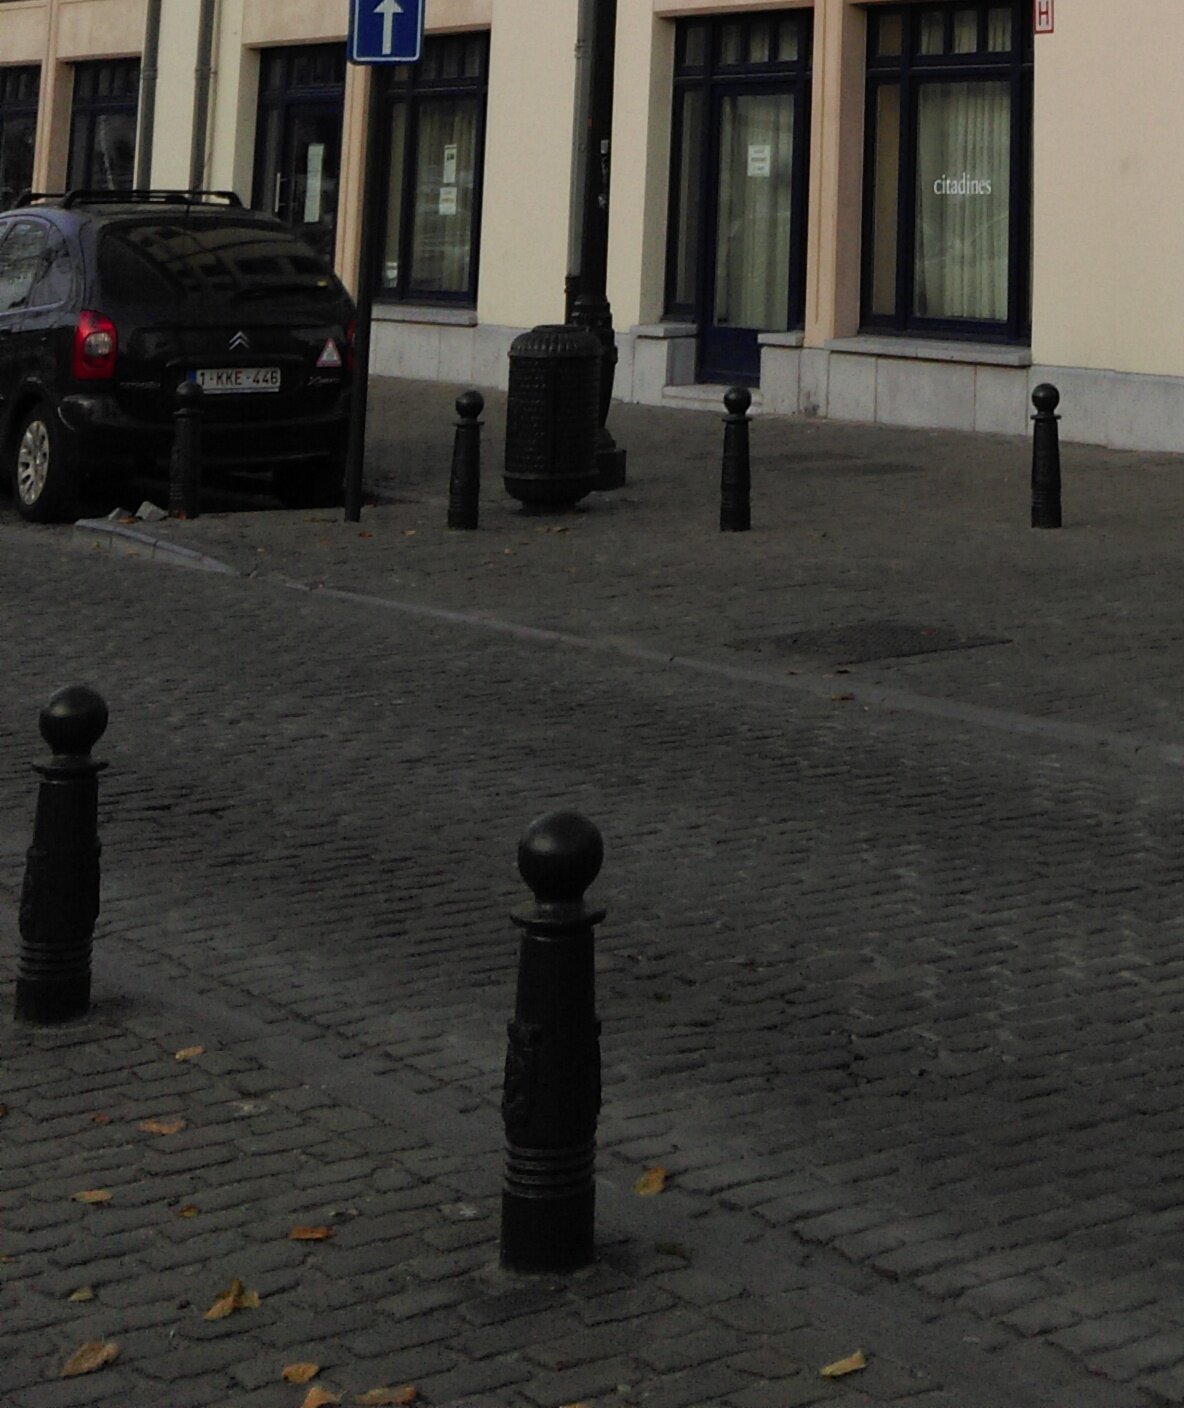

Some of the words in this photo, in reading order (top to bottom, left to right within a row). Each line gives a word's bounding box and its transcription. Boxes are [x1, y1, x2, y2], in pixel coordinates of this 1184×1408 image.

[1038, 0, 1049, 26] H
[933, 172, 992, 195] citadines
[200, 370, 279, 386] 1-KKE-446
